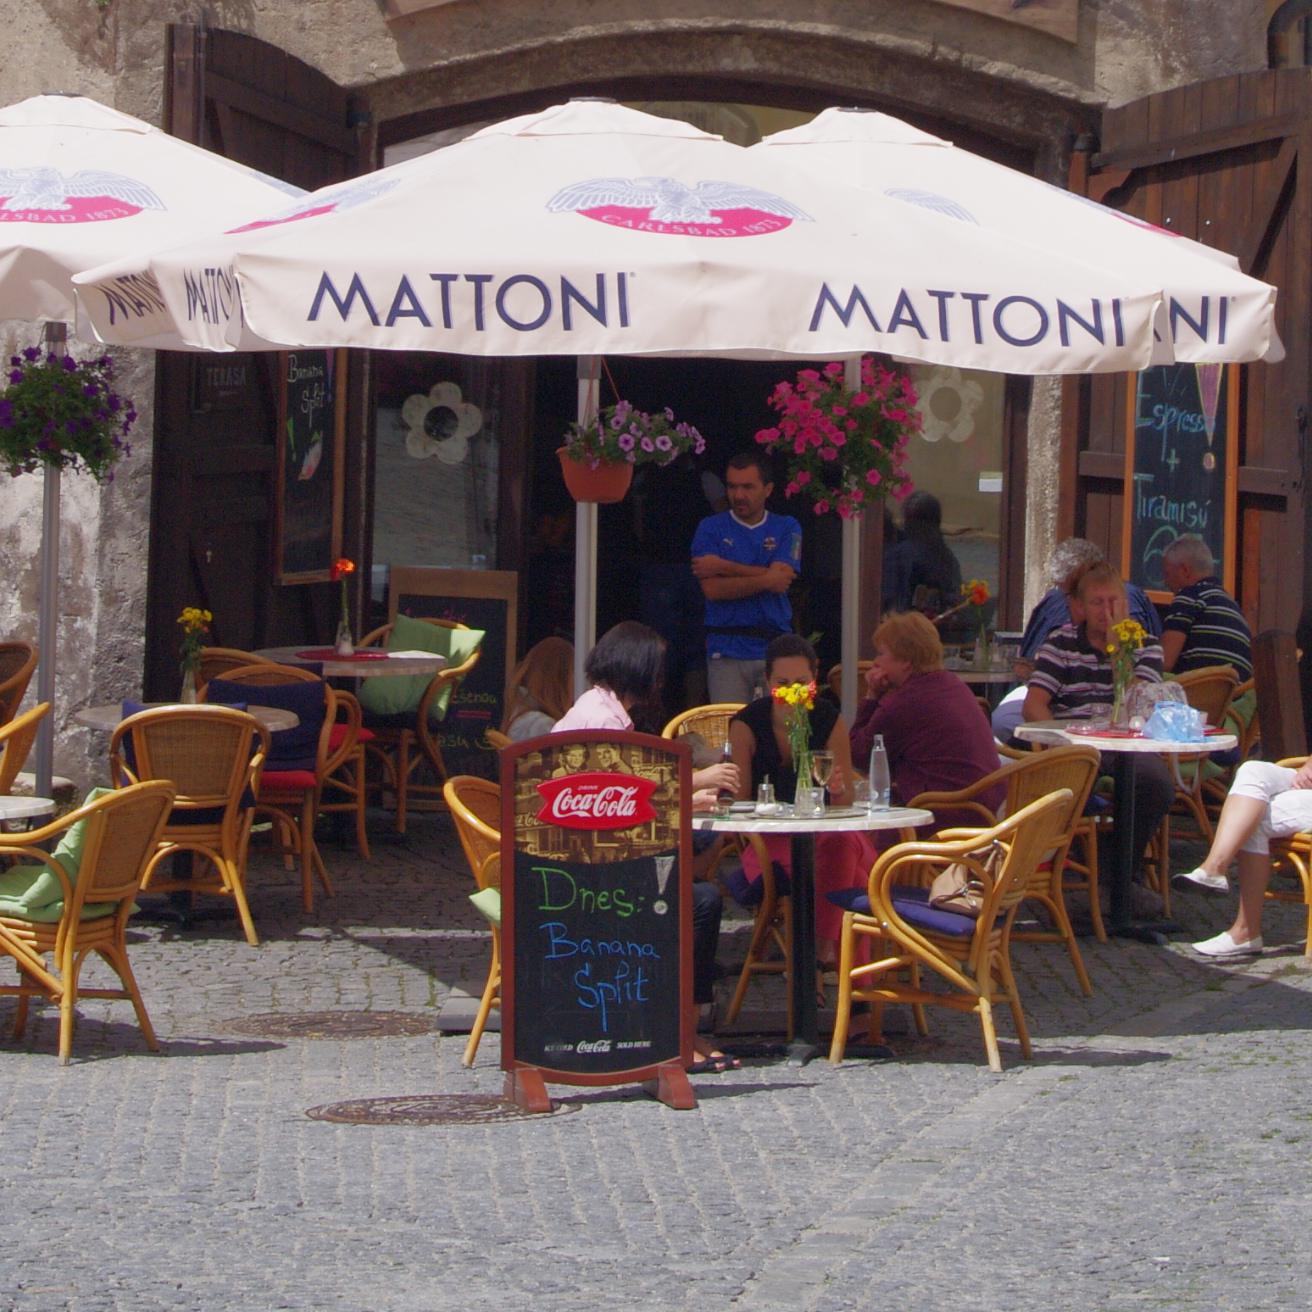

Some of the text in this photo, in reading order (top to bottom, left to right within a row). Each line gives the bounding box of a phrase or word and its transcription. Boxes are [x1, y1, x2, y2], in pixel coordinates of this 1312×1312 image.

[86, 207, 129, 220] 1873
[602, 214, 737, 236] CARLSBAD
[306, 270, 631, 333] MATTONI
[808, 281, 1126, 348] MATTONI
[552, 786, 639, 818] Coca-Cola
[539, 922, 661, 959] Banana
[574, 961, 649, 1032] Split
